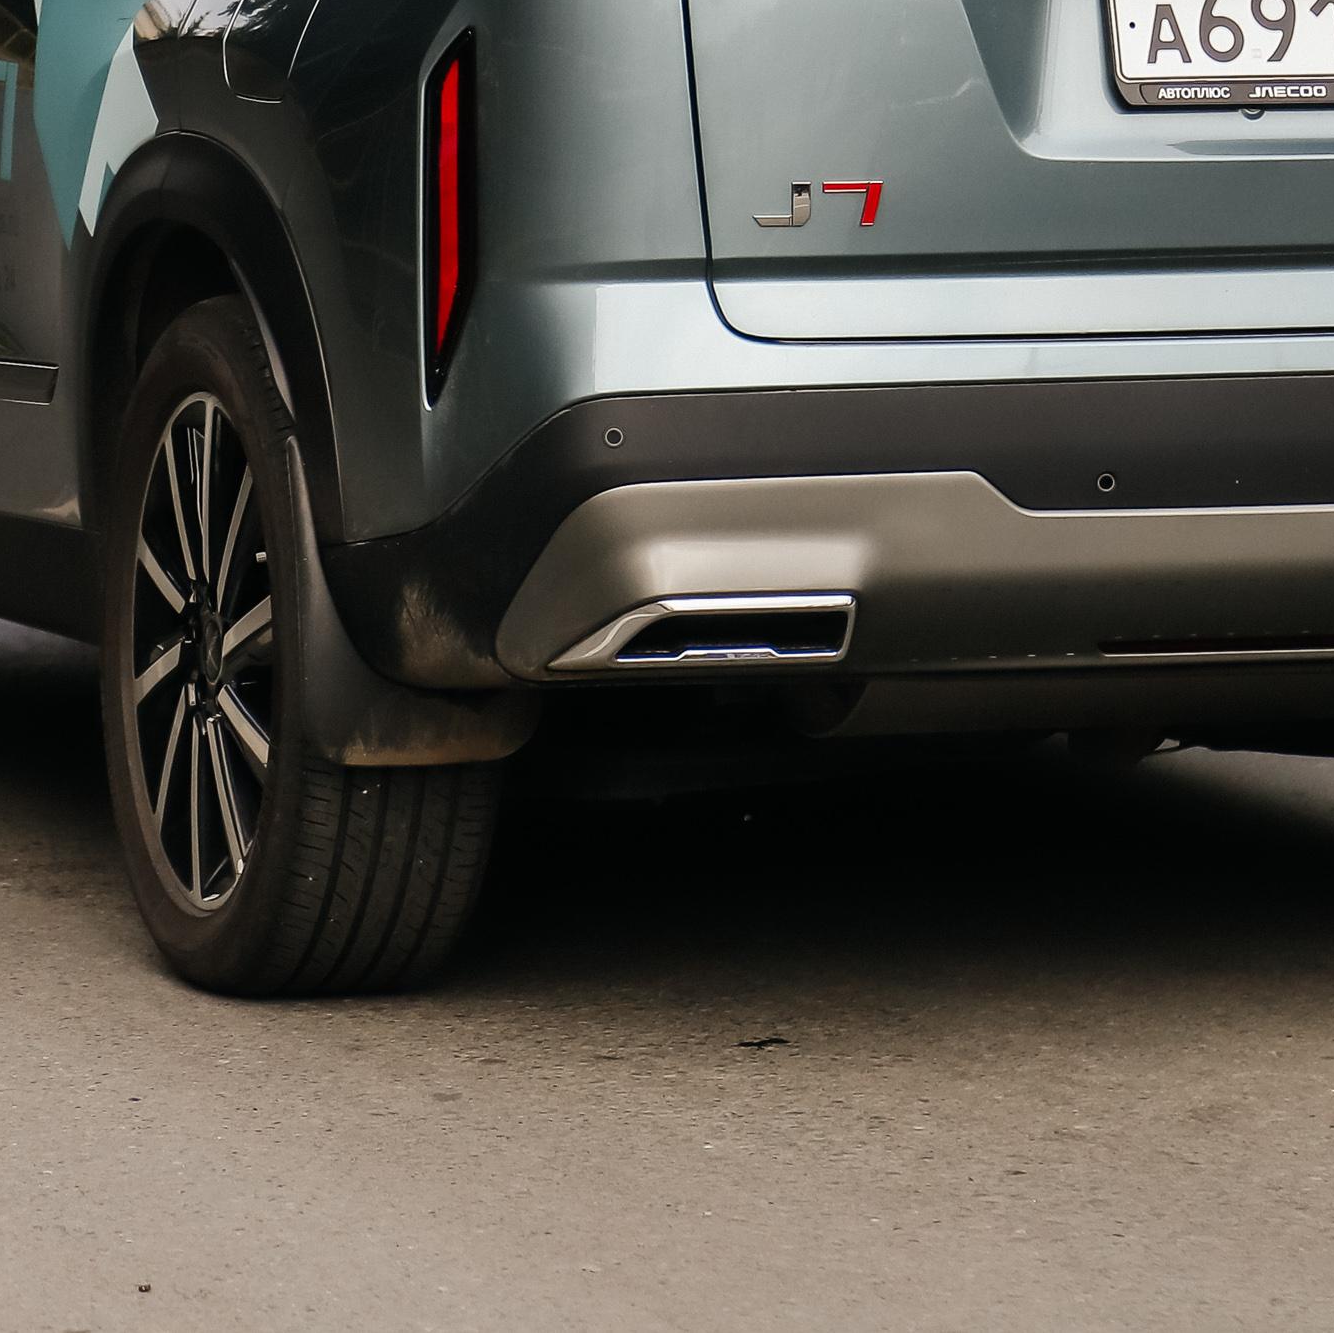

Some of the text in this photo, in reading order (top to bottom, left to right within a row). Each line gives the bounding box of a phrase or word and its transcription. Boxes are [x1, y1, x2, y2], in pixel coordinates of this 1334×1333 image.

[1157, 85, 1231, 100] АВТОПЛЮС
[1248, 85, 1327, 98] JAECOO
[752, 180, 884, 227] J7
